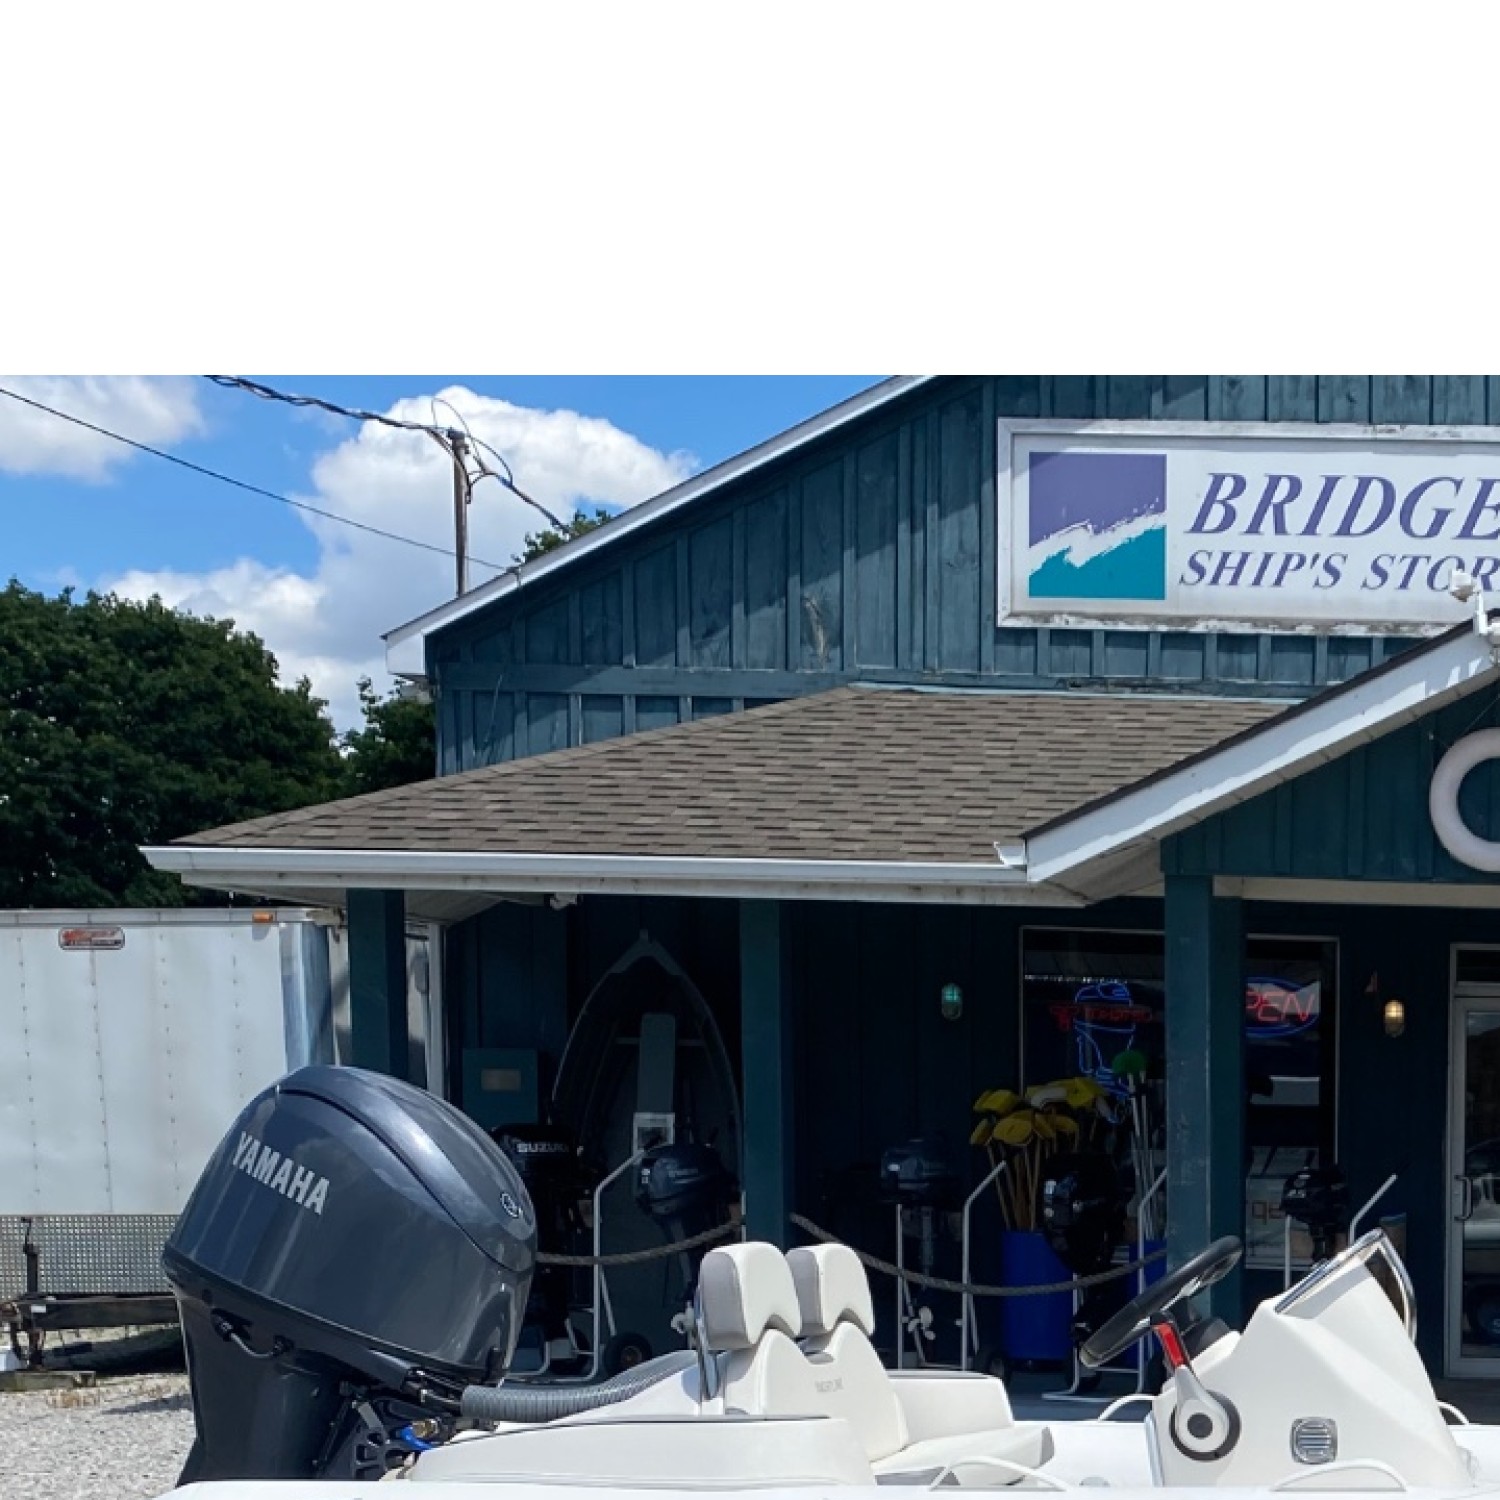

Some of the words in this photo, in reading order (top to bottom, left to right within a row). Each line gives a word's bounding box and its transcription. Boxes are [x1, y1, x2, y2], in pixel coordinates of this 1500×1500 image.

[1179, 550, 1348, 589] SHIP'S
[1246, 991, 1316, 1022] PEN
[233, 1131, 330, 1215] YAMAHA
